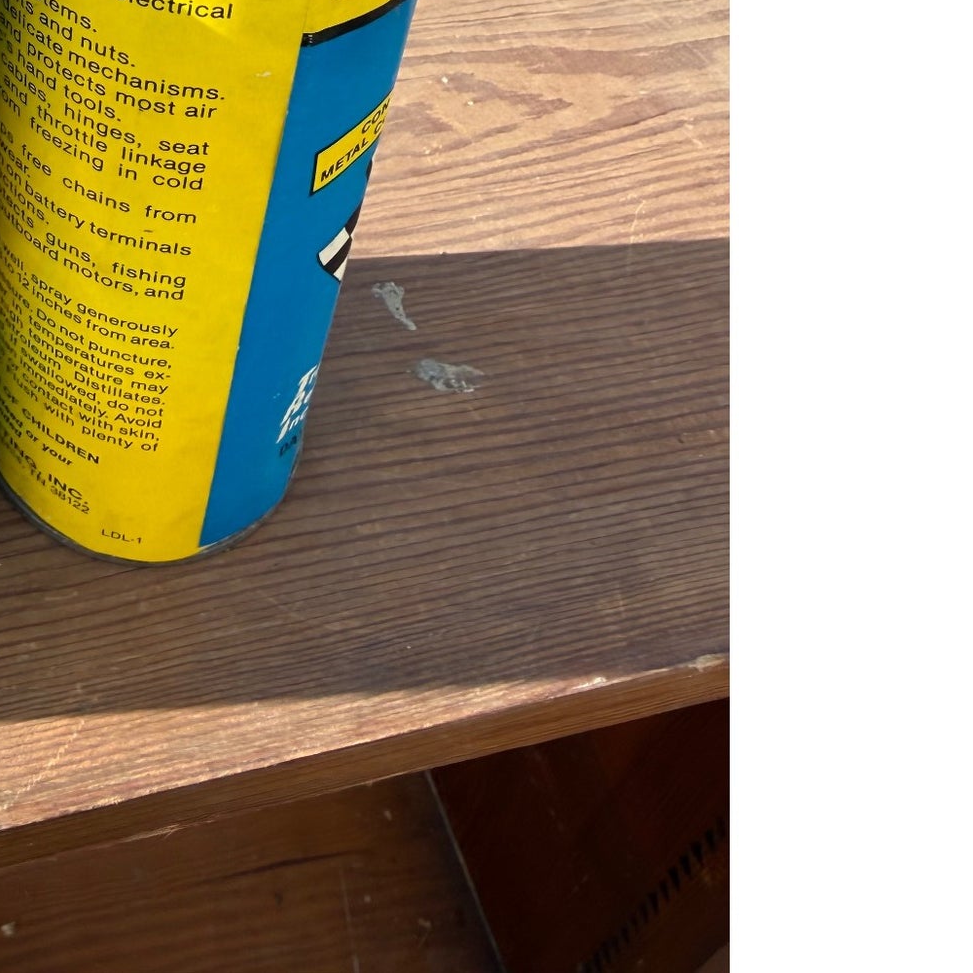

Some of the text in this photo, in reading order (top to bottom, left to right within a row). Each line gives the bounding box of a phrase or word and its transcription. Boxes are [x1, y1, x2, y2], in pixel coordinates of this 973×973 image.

[39, 11, 73, 41] and
[80, 36, 136, 67] nuts.
[1, 51, 210, 156] cables, hinges, seat
[17, 49, 121, 122] hand tools.
[27, 42, 106, 96] protects
[116, 90, 175, 115] most
[184, 101, 218, 118] air
[68, 50, 225, 101] mechanisms.
[3, 74, 207, 176] and throttle linkage
[30, 116, 104, 172] freezing
[118, 164, 138, 181] in
[152, 175, 204, 191] cold
[21, 143, 52, 176] free
[62, 177, 131, 213] chains
[145, 204, 197, 224] from
[320, 137, 369, 182] METAL
[25, 179, 85, 229] battery
[89, 221, 192, 256] terminals
[46, 232, 96, 267] guns,
[112, 261, 187, 289] fishing
[63, 257, 139, 296] motors,
[144, 285, 184, 301] and
[17, 272, 30, 290] 12
[32, 285, 82, 324] inches
[86, 319, 126, 342] from
[130, 336, 175, 350] area.
[31, 273, 72, 306] spray
[77, 302, 179, 338] generously
[36, 308, 56, 328] Do
[59, 325, 85, 345] not
[88, 340, 172, 369] puncture,
[28, 315, 135, 376] temperatures
[143, 368, 171, 381] ex-
[28, 328, 169, 395] temperature may
[20, 357, 110, 419] immediately.
[114, 413, 163, 429] Avoid
[21, 347, 101, 405] swallowed,
[107, 399, 129, 412] do
[135, 404, 164, 417] not
[22, 372, 74, 415] contact
[78, 411, 114, 431] with
[119, 424, 160, 442] skin,
[74, 370, 166, 405] Distillates.
[22, 407, 100, 465] CHILDREN
[42, 443, 73, 466] your
[44, 402, 75, 427] with
[81, 425, 133, 450] plenty
[140, 441, 159, 452] of
[48, 473, 89, 504] INC.
